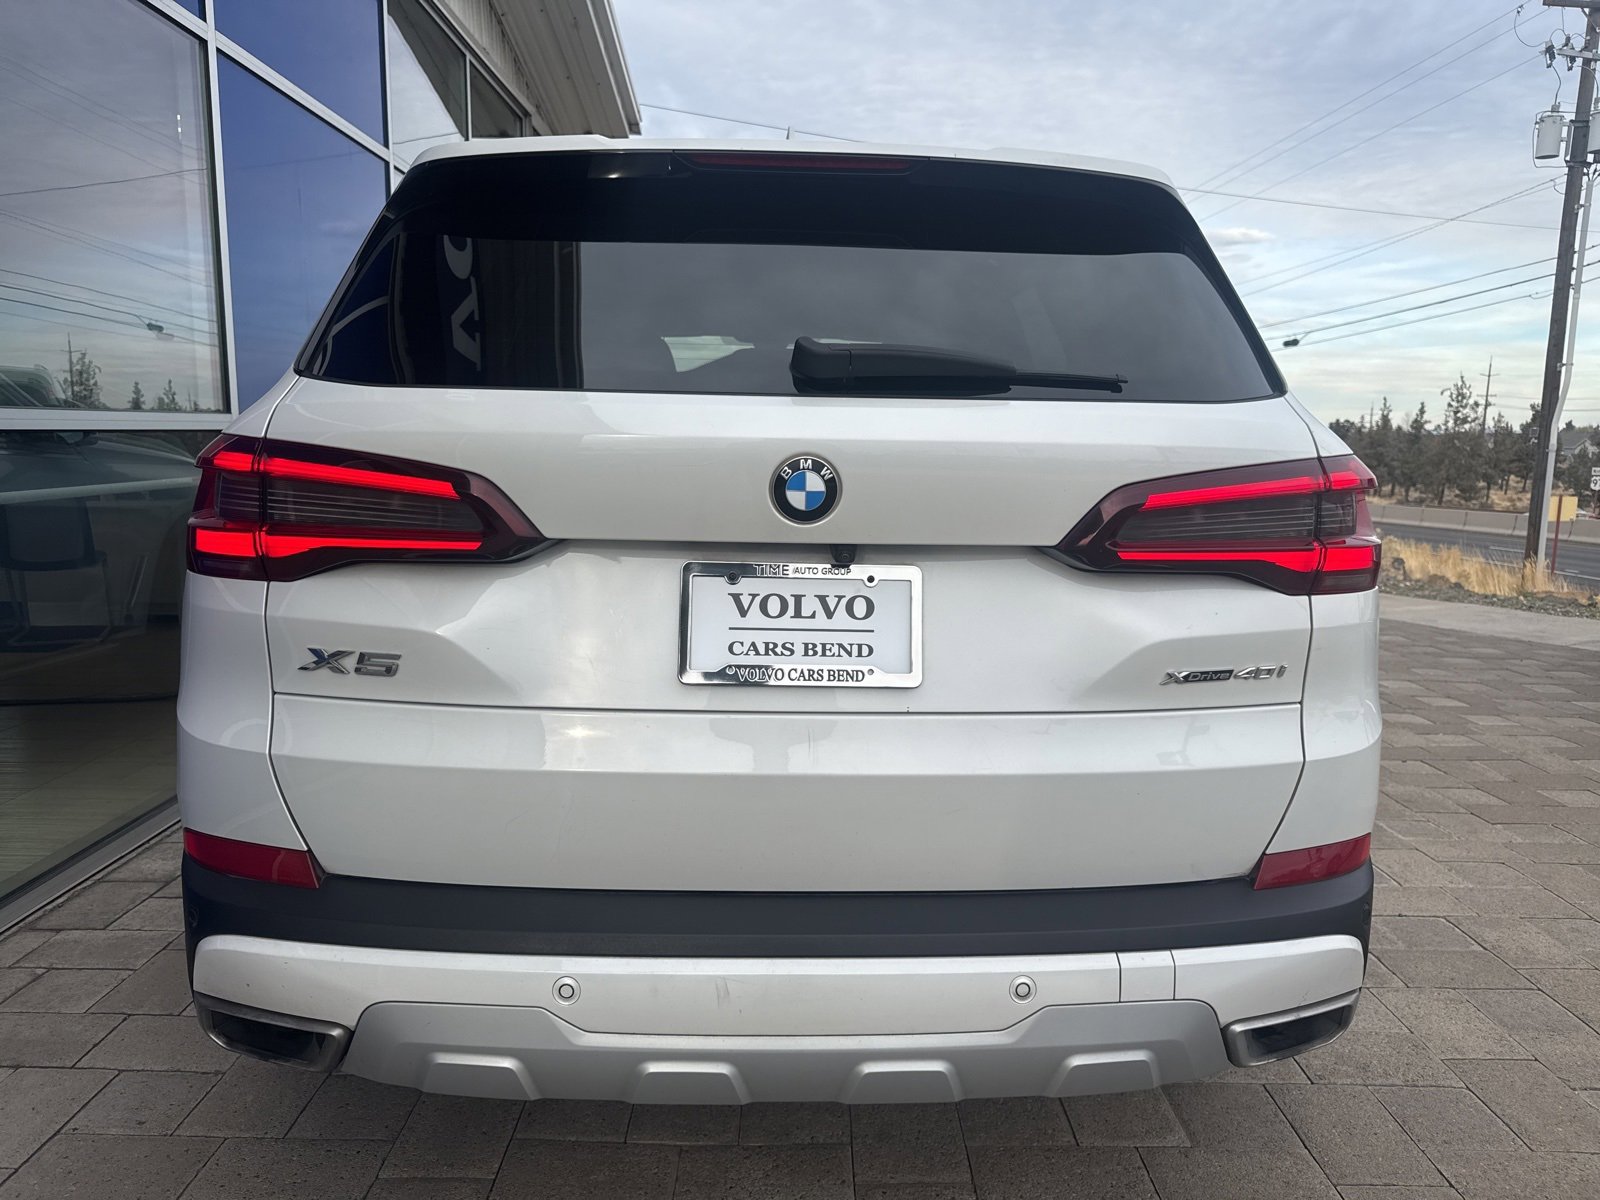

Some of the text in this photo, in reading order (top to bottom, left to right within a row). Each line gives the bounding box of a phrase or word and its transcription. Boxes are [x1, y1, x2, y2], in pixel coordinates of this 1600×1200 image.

[780, 458, 833, 480] BMW
[753, 563, 852, 577] TIME AUTO GROUP
[727, 592, 875, 620] VOLVO
[727, 640, 874, 658] CARS BEND
[297, 646, 402, 677] X5
[735, 666, 865, 683] VOLVO CARS BEND
